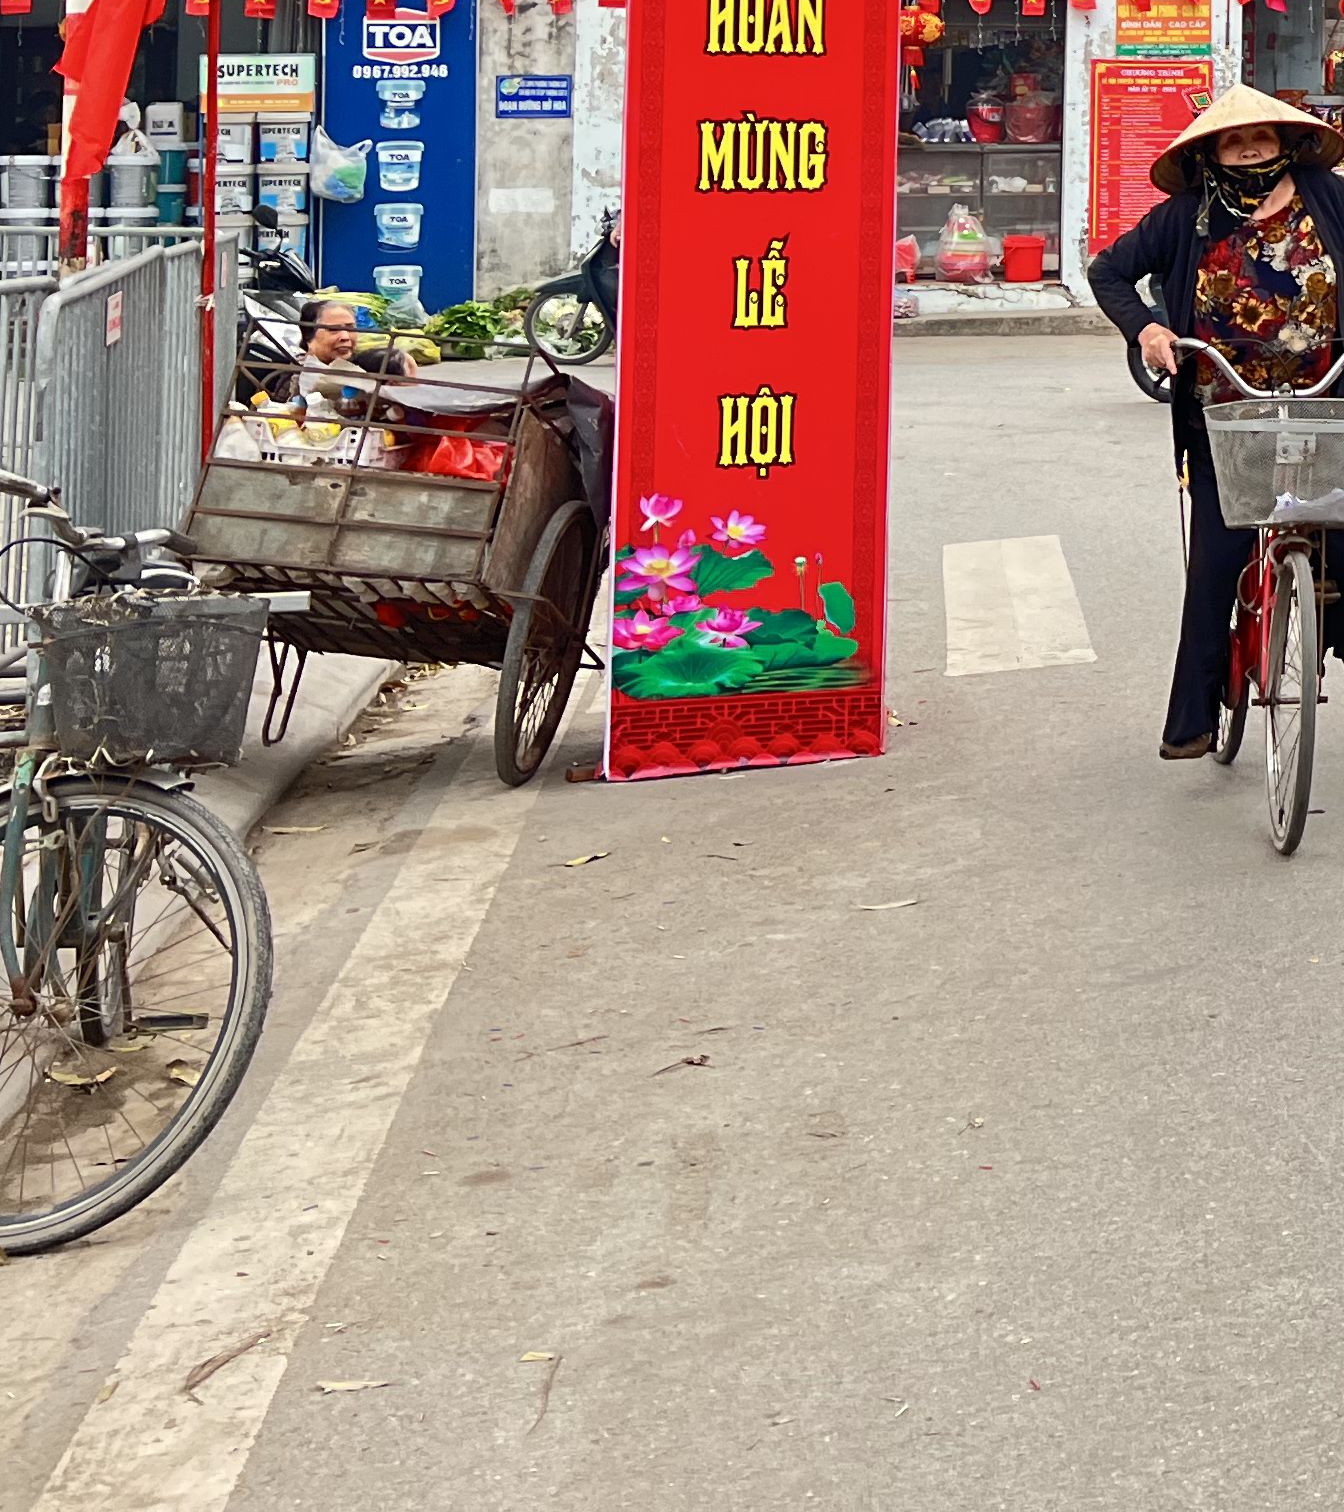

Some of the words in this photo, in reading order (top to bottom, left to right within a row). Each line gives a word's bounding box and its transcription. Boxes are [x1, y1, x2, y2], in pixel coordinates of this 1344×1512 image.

[369, 26, 434, 47] TOA
[218, 64, 299, 78] SUPERTECH
[700, 114, 825, 190] MỪNG
[720, 387, 793, 476] HỘI
